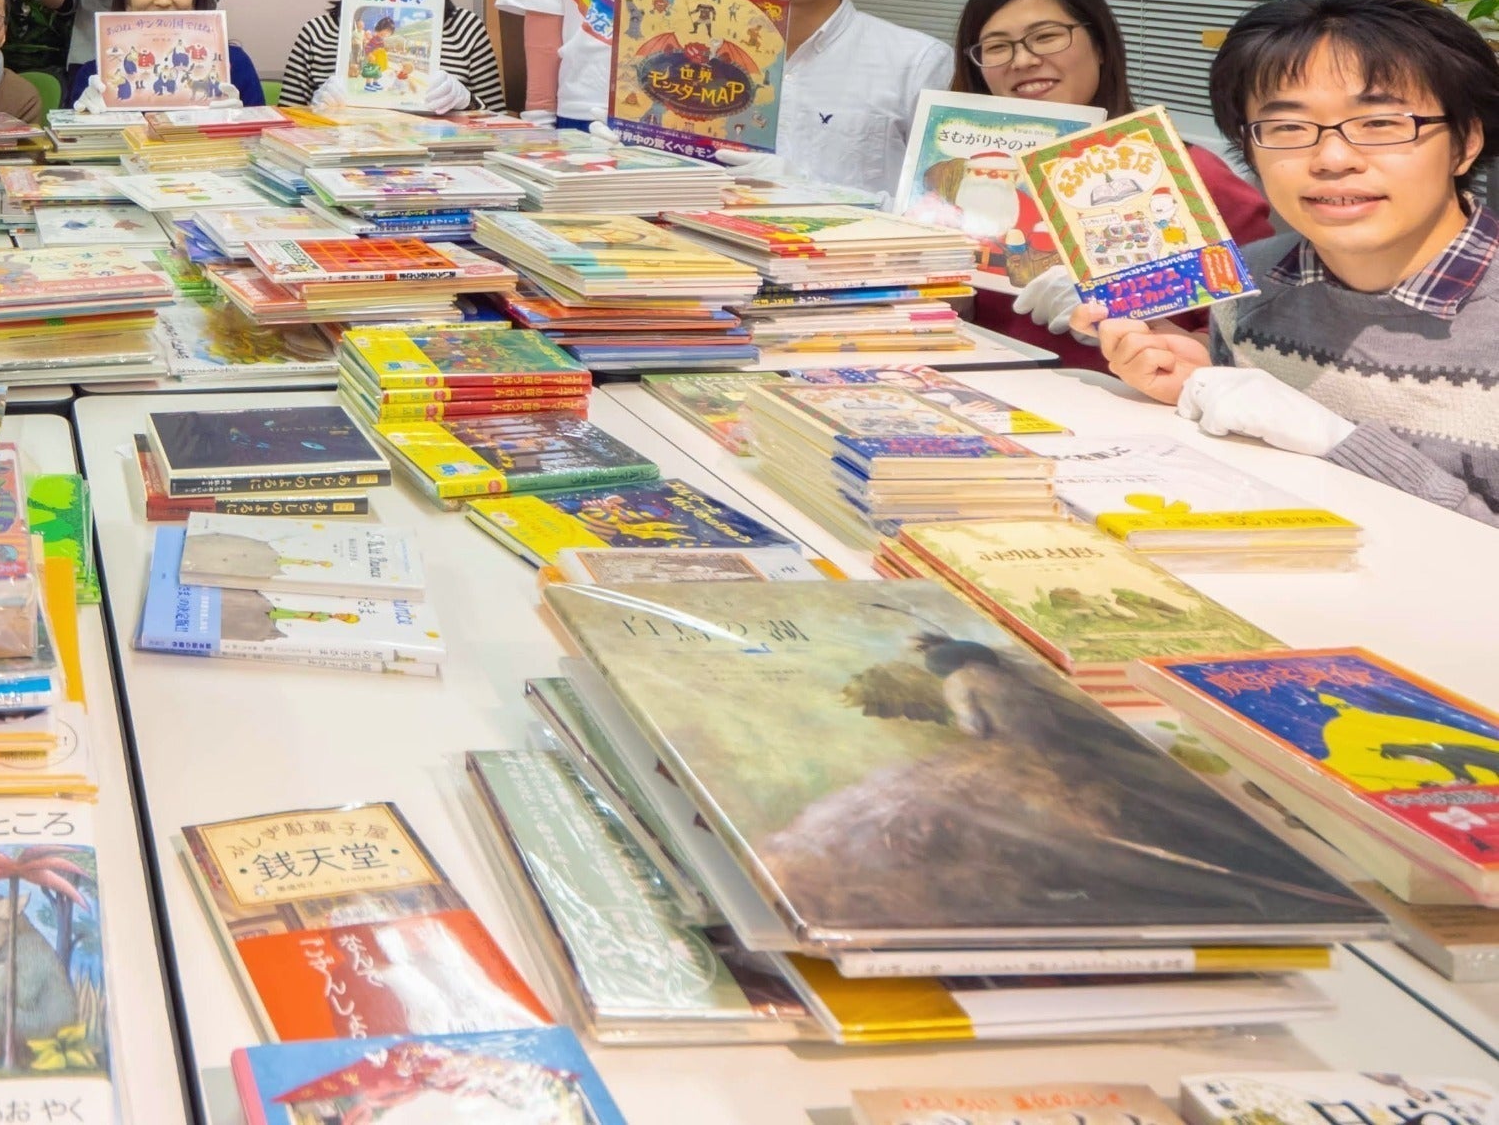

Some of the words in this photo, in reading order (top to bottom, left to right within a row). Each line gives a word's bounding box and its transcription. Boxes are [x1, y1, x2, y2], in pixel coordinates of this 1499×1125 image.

[679, 64, 713, 84] 世界
[1057, 144, 1158, 199] あるかしら書店
[250, 474, 351, 490] あらしのよるに
[226, 501, 328, 515] あらしのよるに
[226, 819, 389, 860] ふしぎ駄菓子屋
[252, 841, 389, 883] 銭天堂
